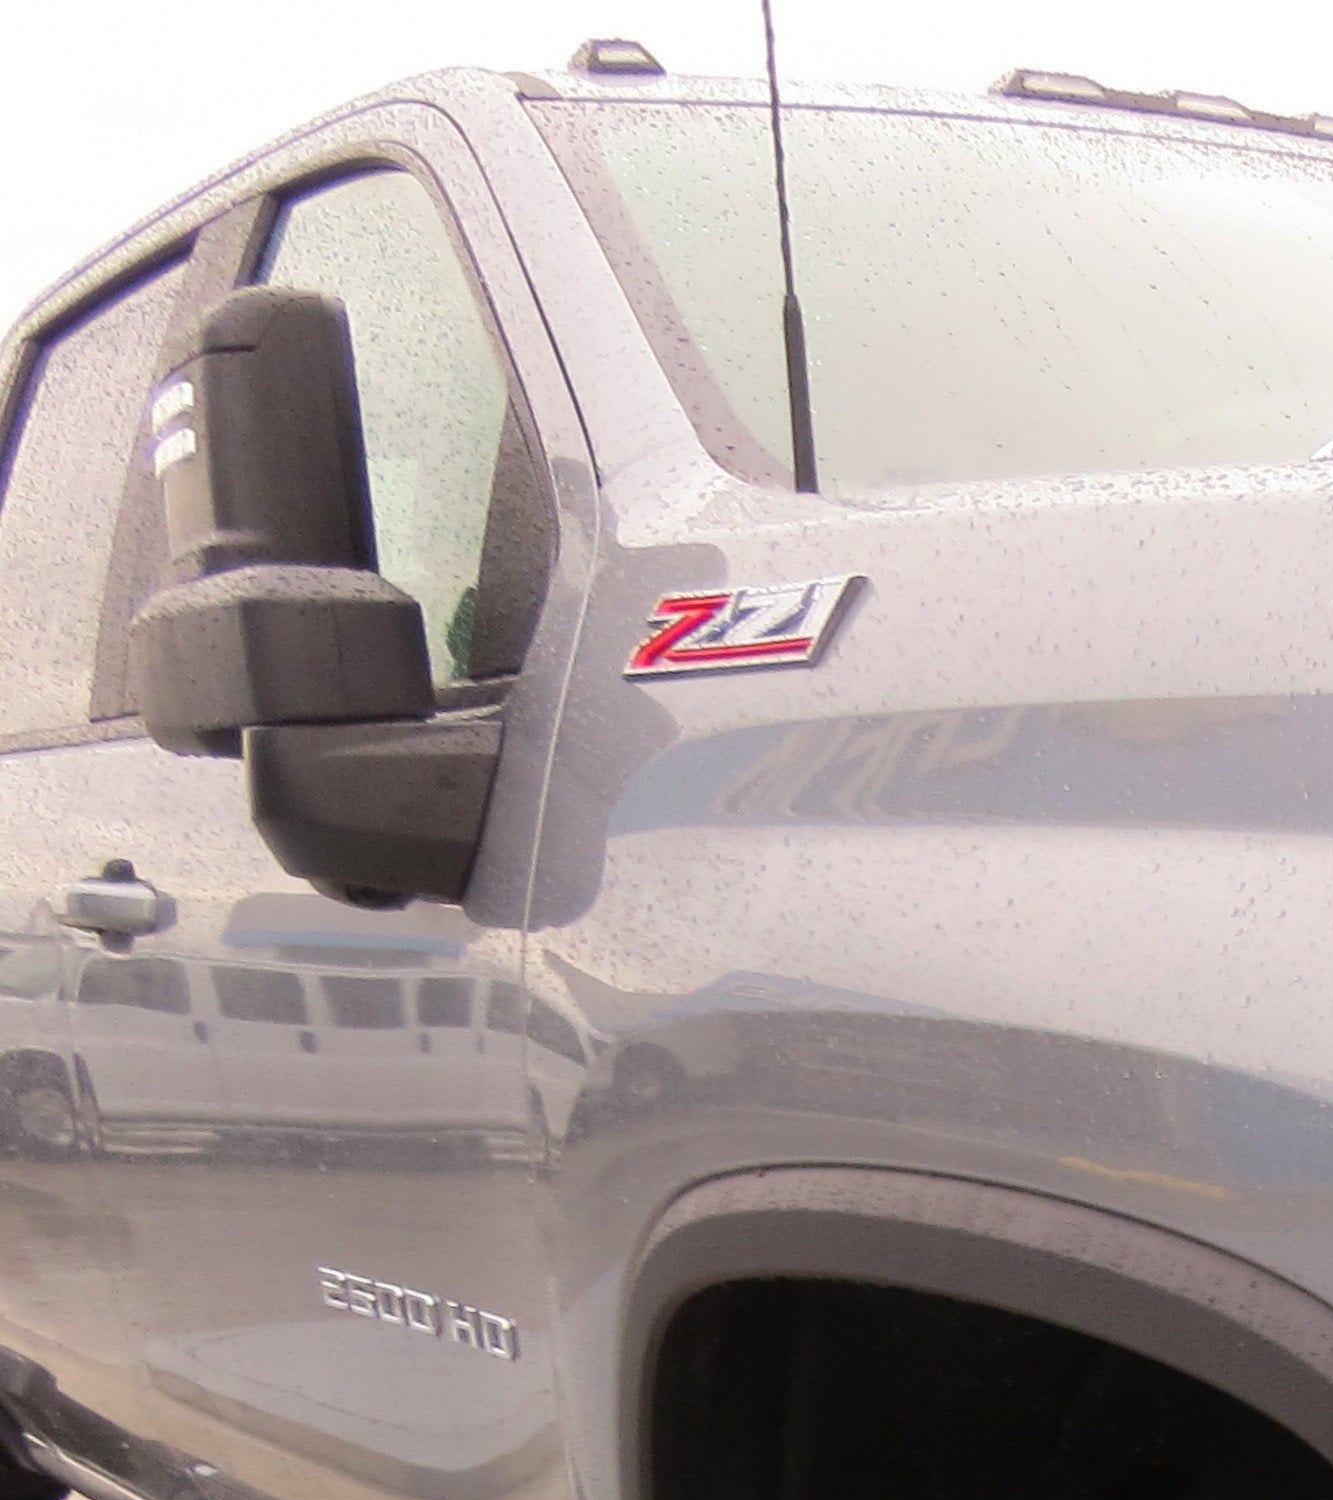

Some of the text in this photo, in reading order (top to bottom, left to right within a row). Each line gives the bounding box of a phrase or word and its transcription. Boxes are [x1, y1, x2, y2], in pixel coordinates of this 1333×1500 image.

[622, 572, 869, 679] Z71
[317, 1265, 521, 1361] 2500 HD
